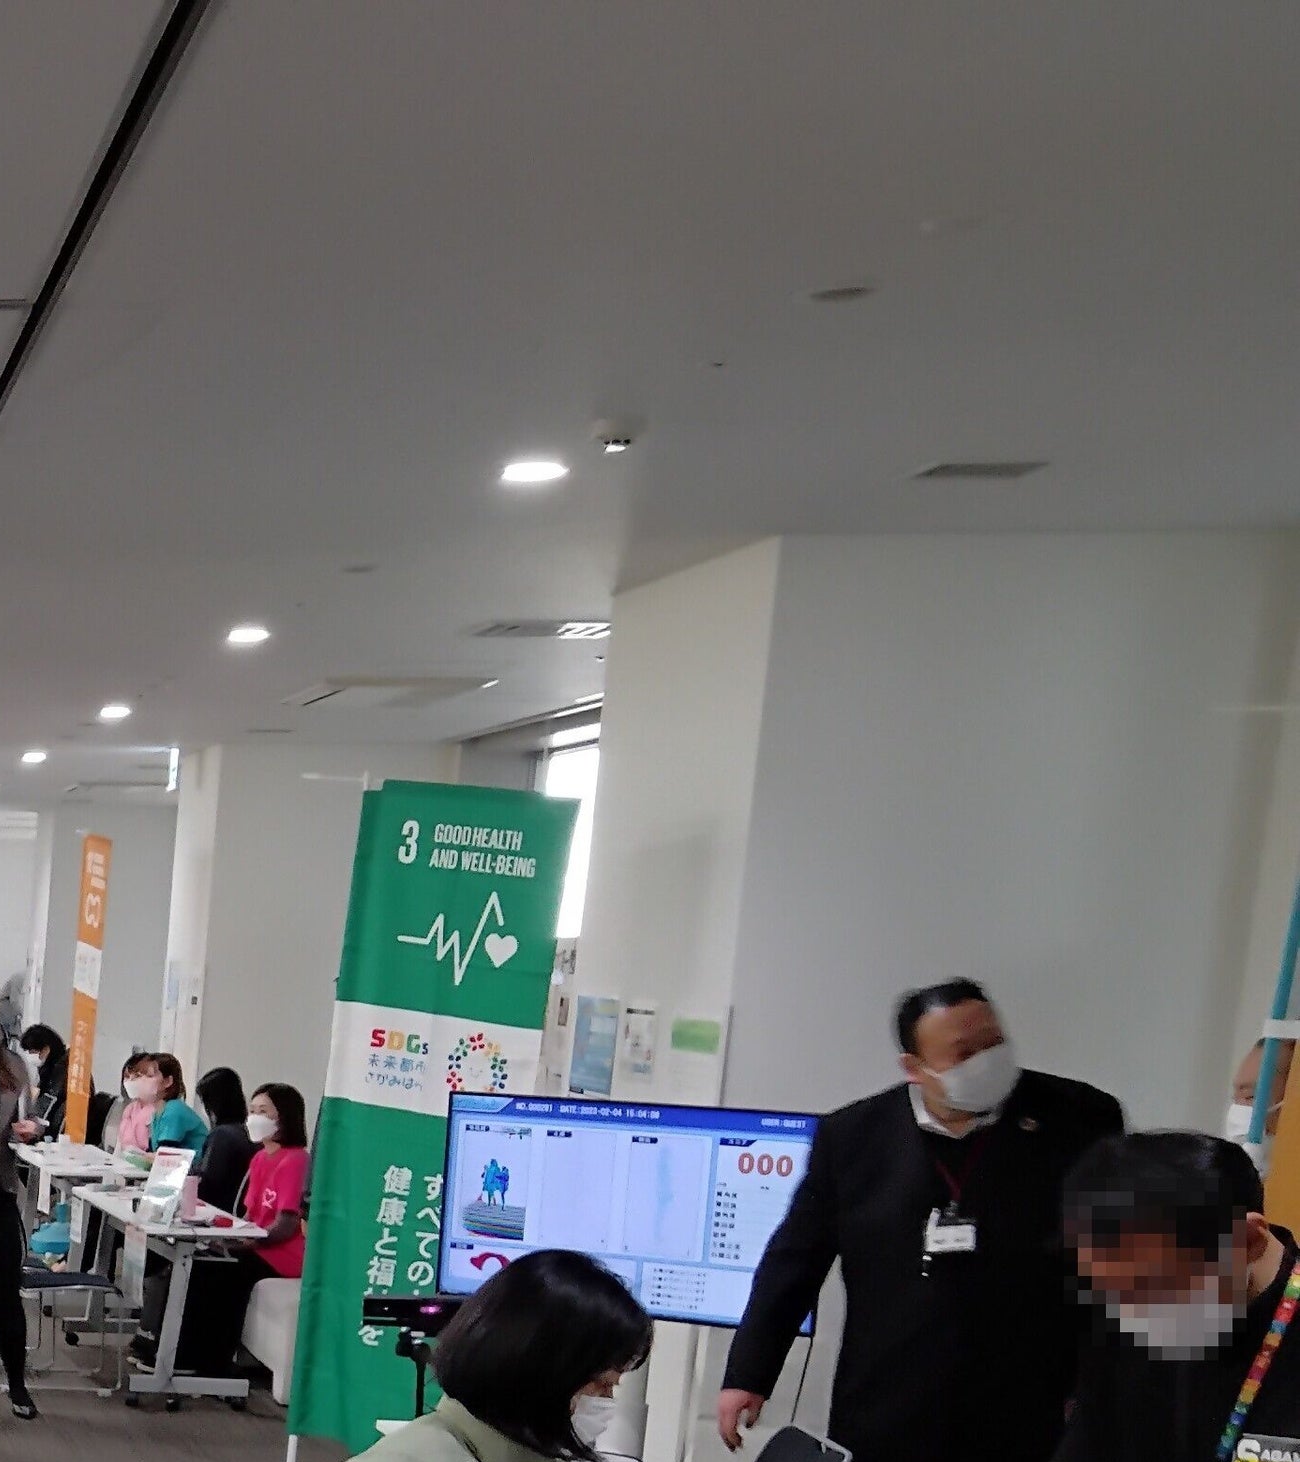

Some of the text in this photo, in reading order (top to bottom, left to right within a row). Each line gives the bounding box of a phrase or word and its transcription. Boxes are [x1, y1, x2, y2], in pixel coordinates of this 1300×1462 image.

[398, 820, 419, 864] 3
[434, 823, 523, 851] GOOD HEALTH
[429, 848, 536, 878] AND WELL-BEING
[370, 1028, 429, 1055] SDGs
[738, 1152, 793, 1177] 000
[357, 1165, 412, 1346] 健康と福を
